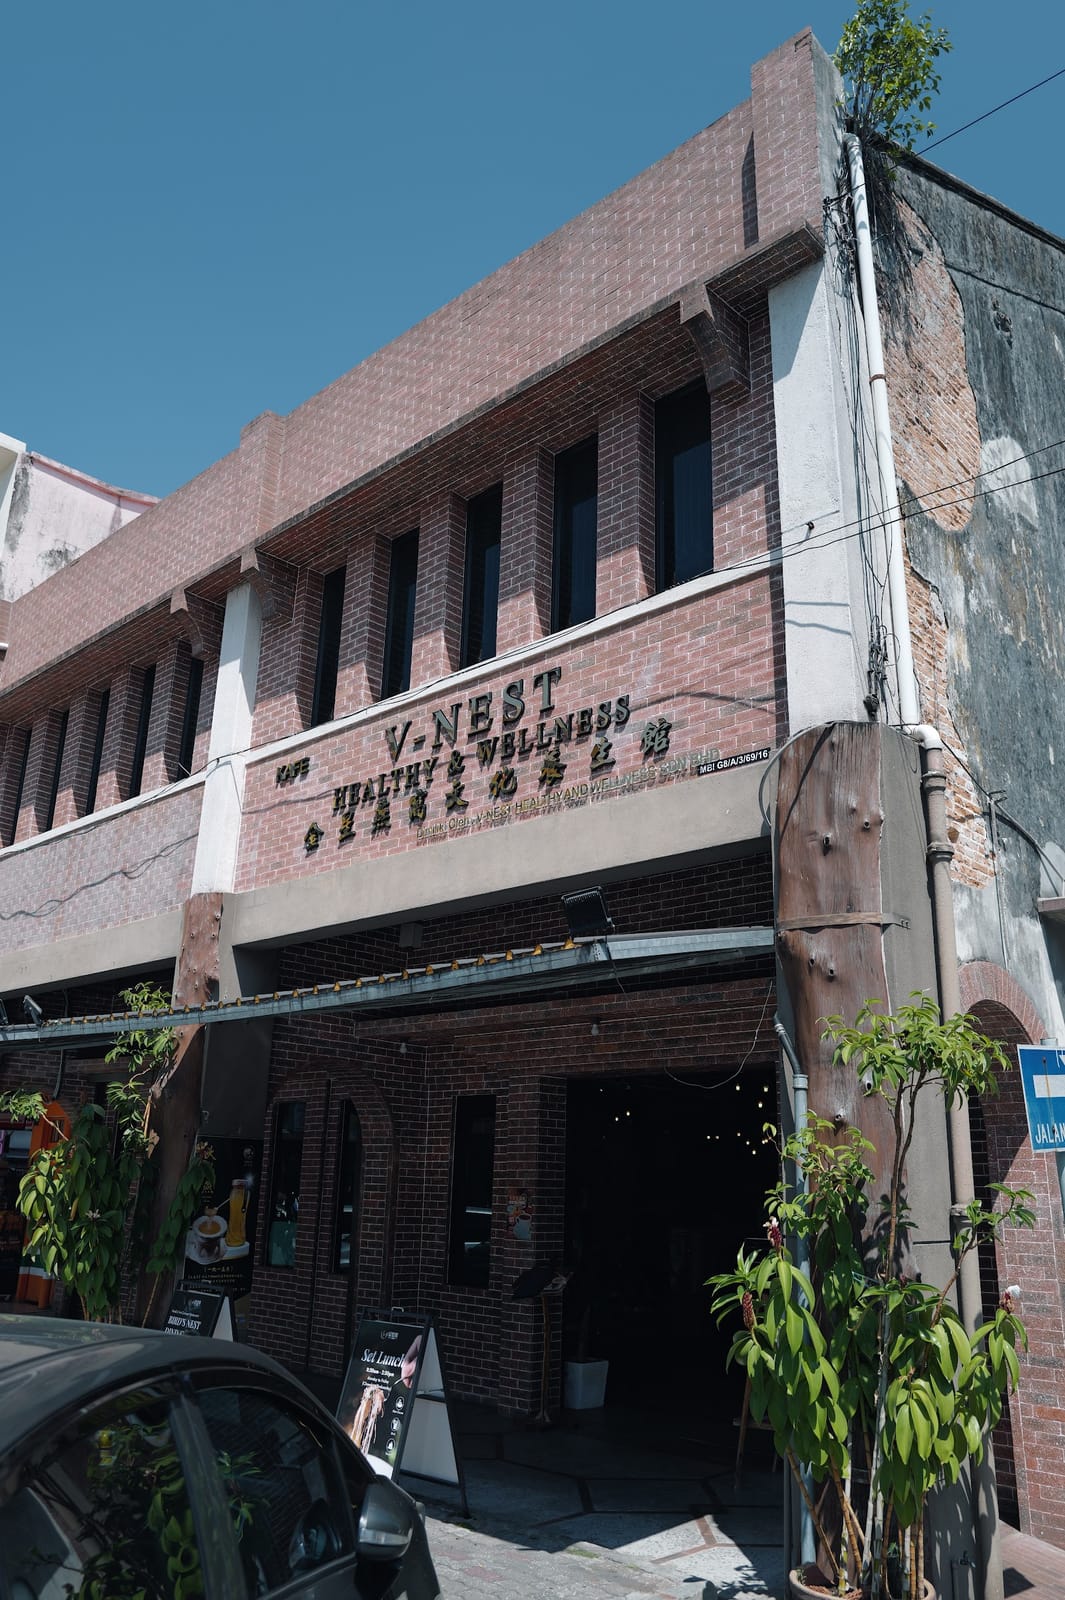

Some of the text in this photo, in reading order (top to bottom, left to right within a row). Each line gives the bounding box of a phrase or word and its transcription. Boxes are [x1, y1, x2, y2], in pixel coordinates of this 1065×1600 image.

[385, 666, 562, 763] V-NEST
[276, 757, 310, 784] KAFE
[333, 694, 630, 811] HEALTHY & WELLNESS
[515, 789, 563, 813] HEALTHY
[563, 783, 589, 802] AND
[590, 766, 656, 796] WELLNESS
[360, 1348, 406, 1369] Set Lunch
